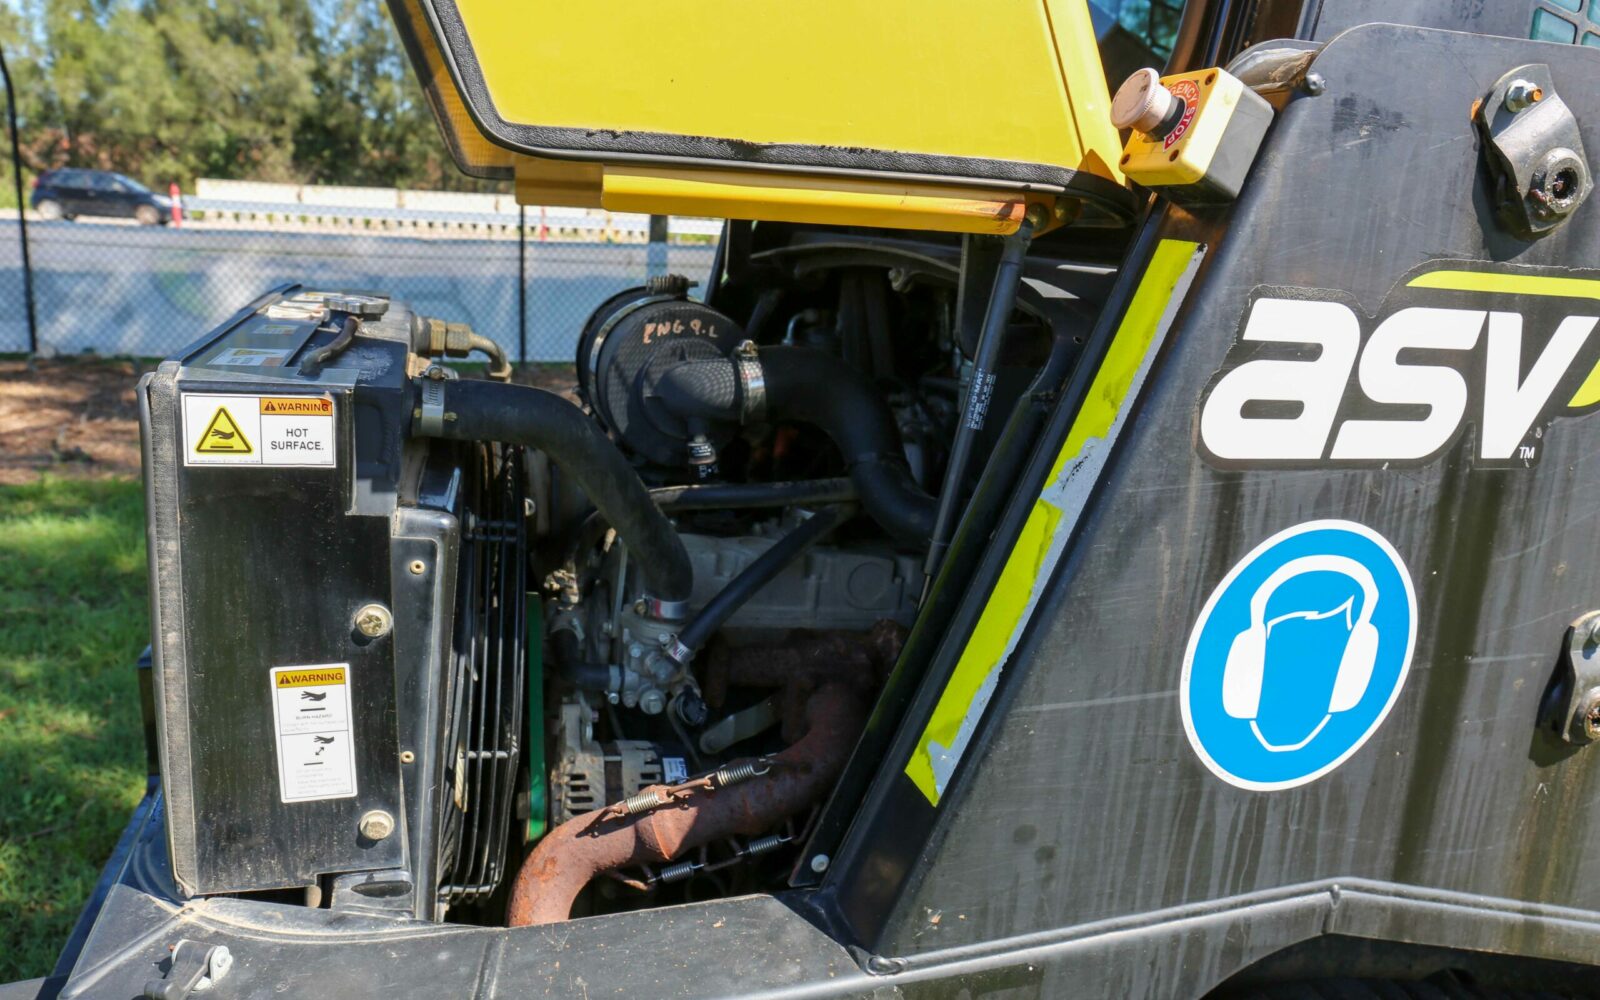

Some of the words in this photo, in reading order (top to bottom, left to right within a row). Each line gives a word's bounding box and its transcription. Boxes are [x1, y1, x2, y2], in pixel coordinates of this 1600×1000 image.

[1167, 106, 1196, 144] STOP
[278, 403, 329, 412] WARNING
[286, 428, 308, 438] HOT
[270, 441, 324, 451] SURFACE.
[1519, 446, 1535, 459] TM
[291, 672, 343, 683] WARNING
